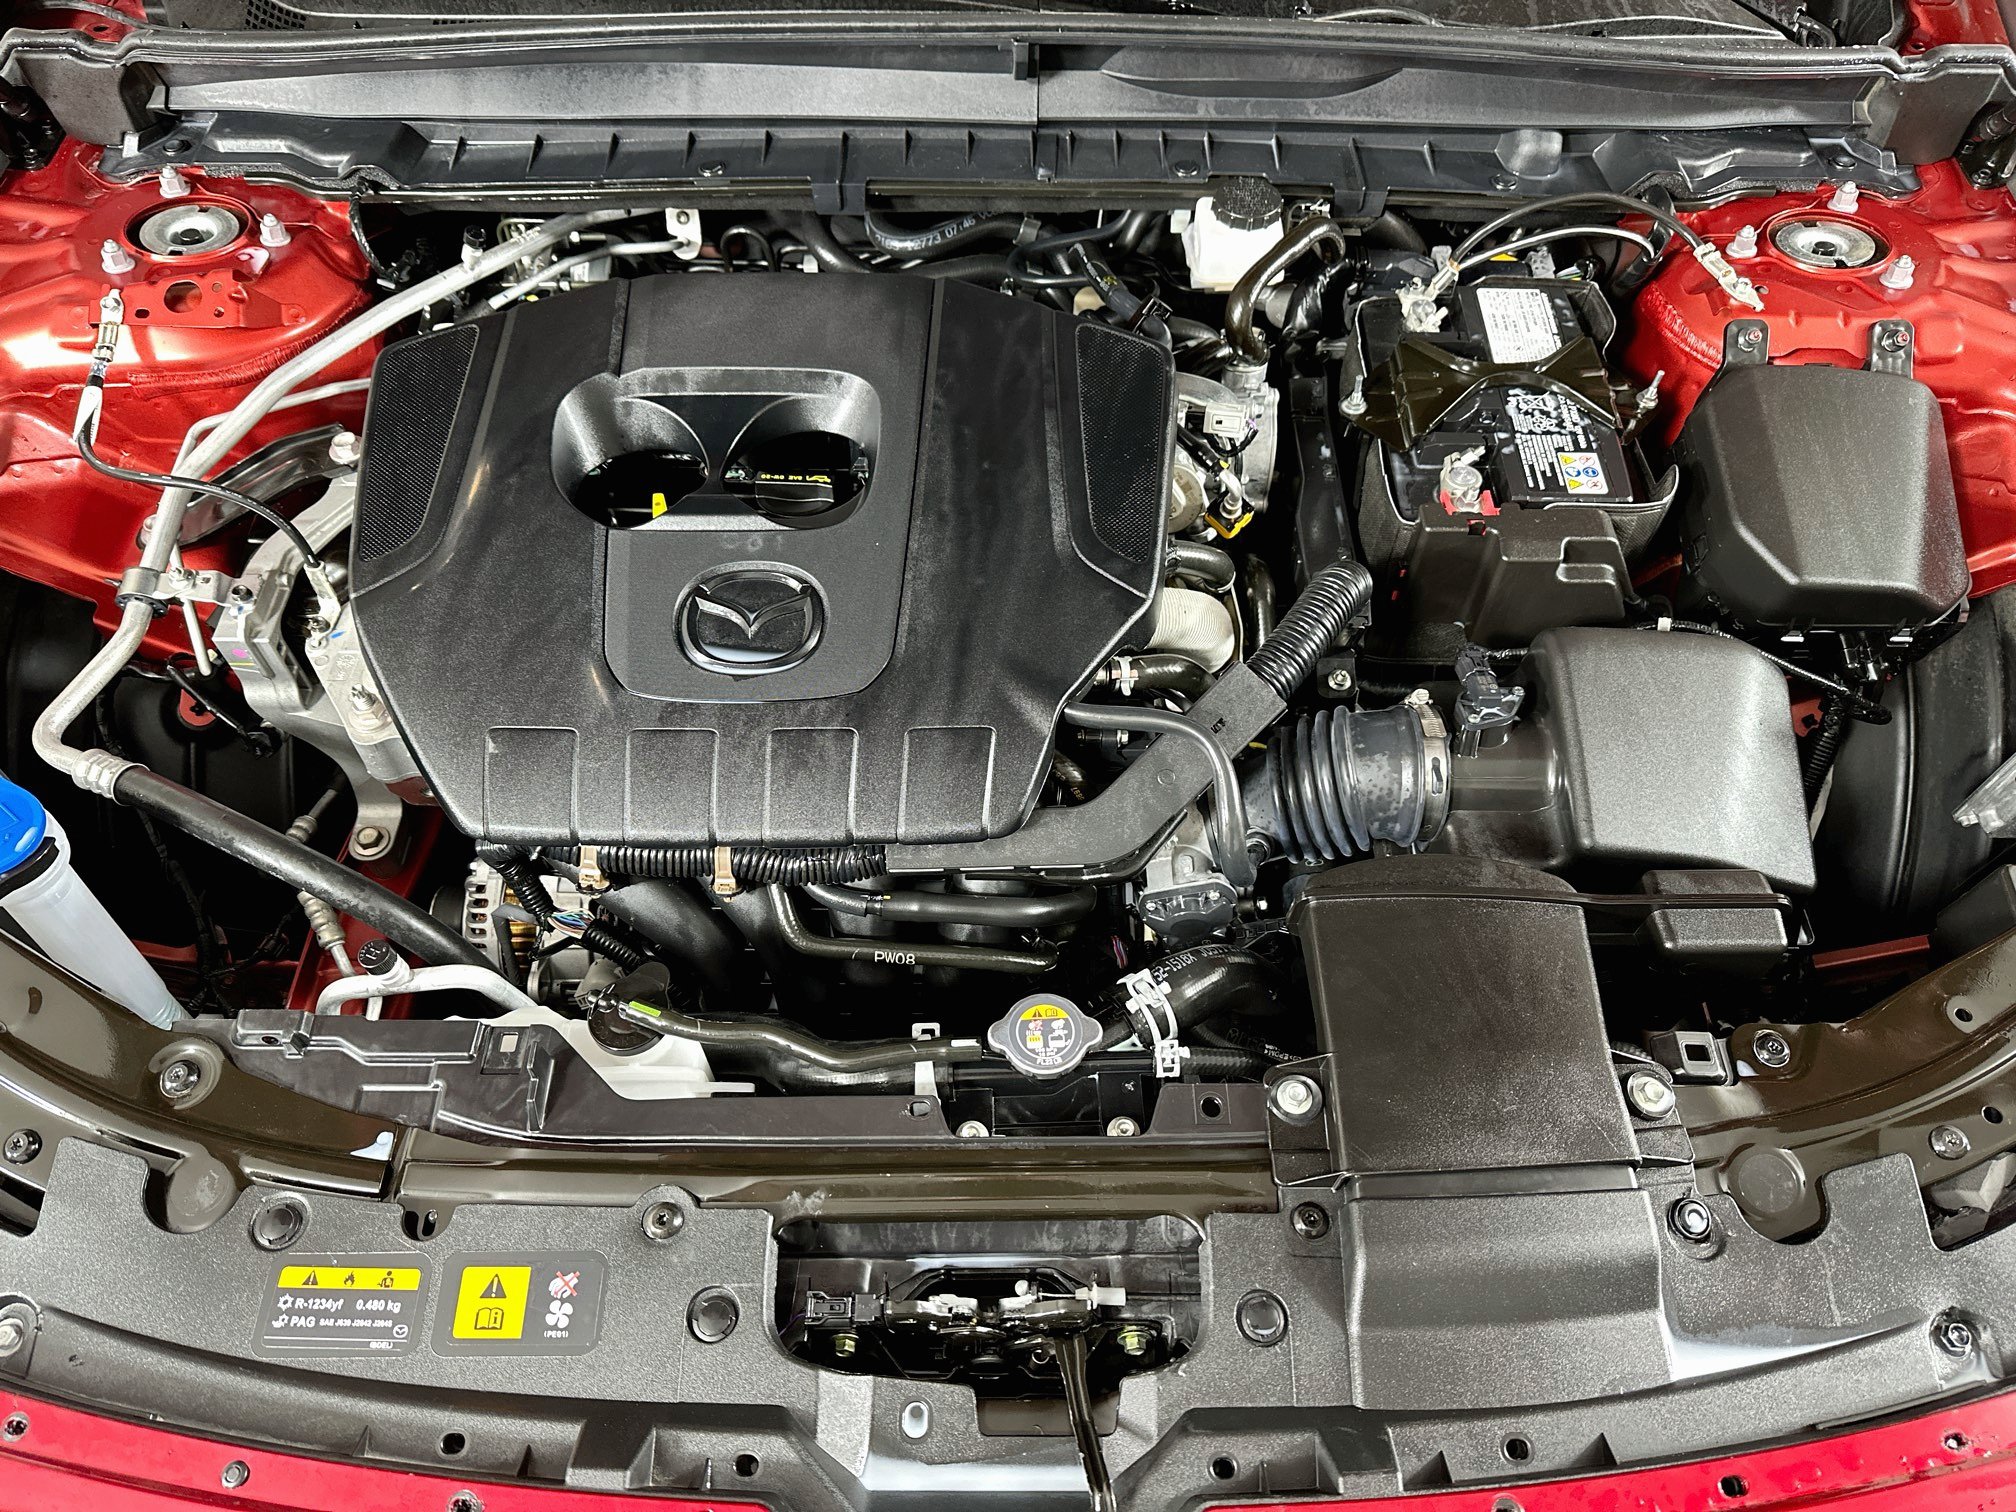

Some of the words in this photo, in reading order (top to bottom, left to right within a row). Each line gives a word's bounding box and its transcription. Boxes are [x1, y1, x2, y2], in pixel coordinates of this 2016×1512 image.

[874, 950, 916, 965] PW08
[294, 1298, 344, 1313] R-1234yf
[355, 1298, 385, 1311] 0.480
[386, 1299, 402, 1314] kg
[290, 1315, 316, 1327] PAG
[543, 1330, 569, 1338] (PE01)
